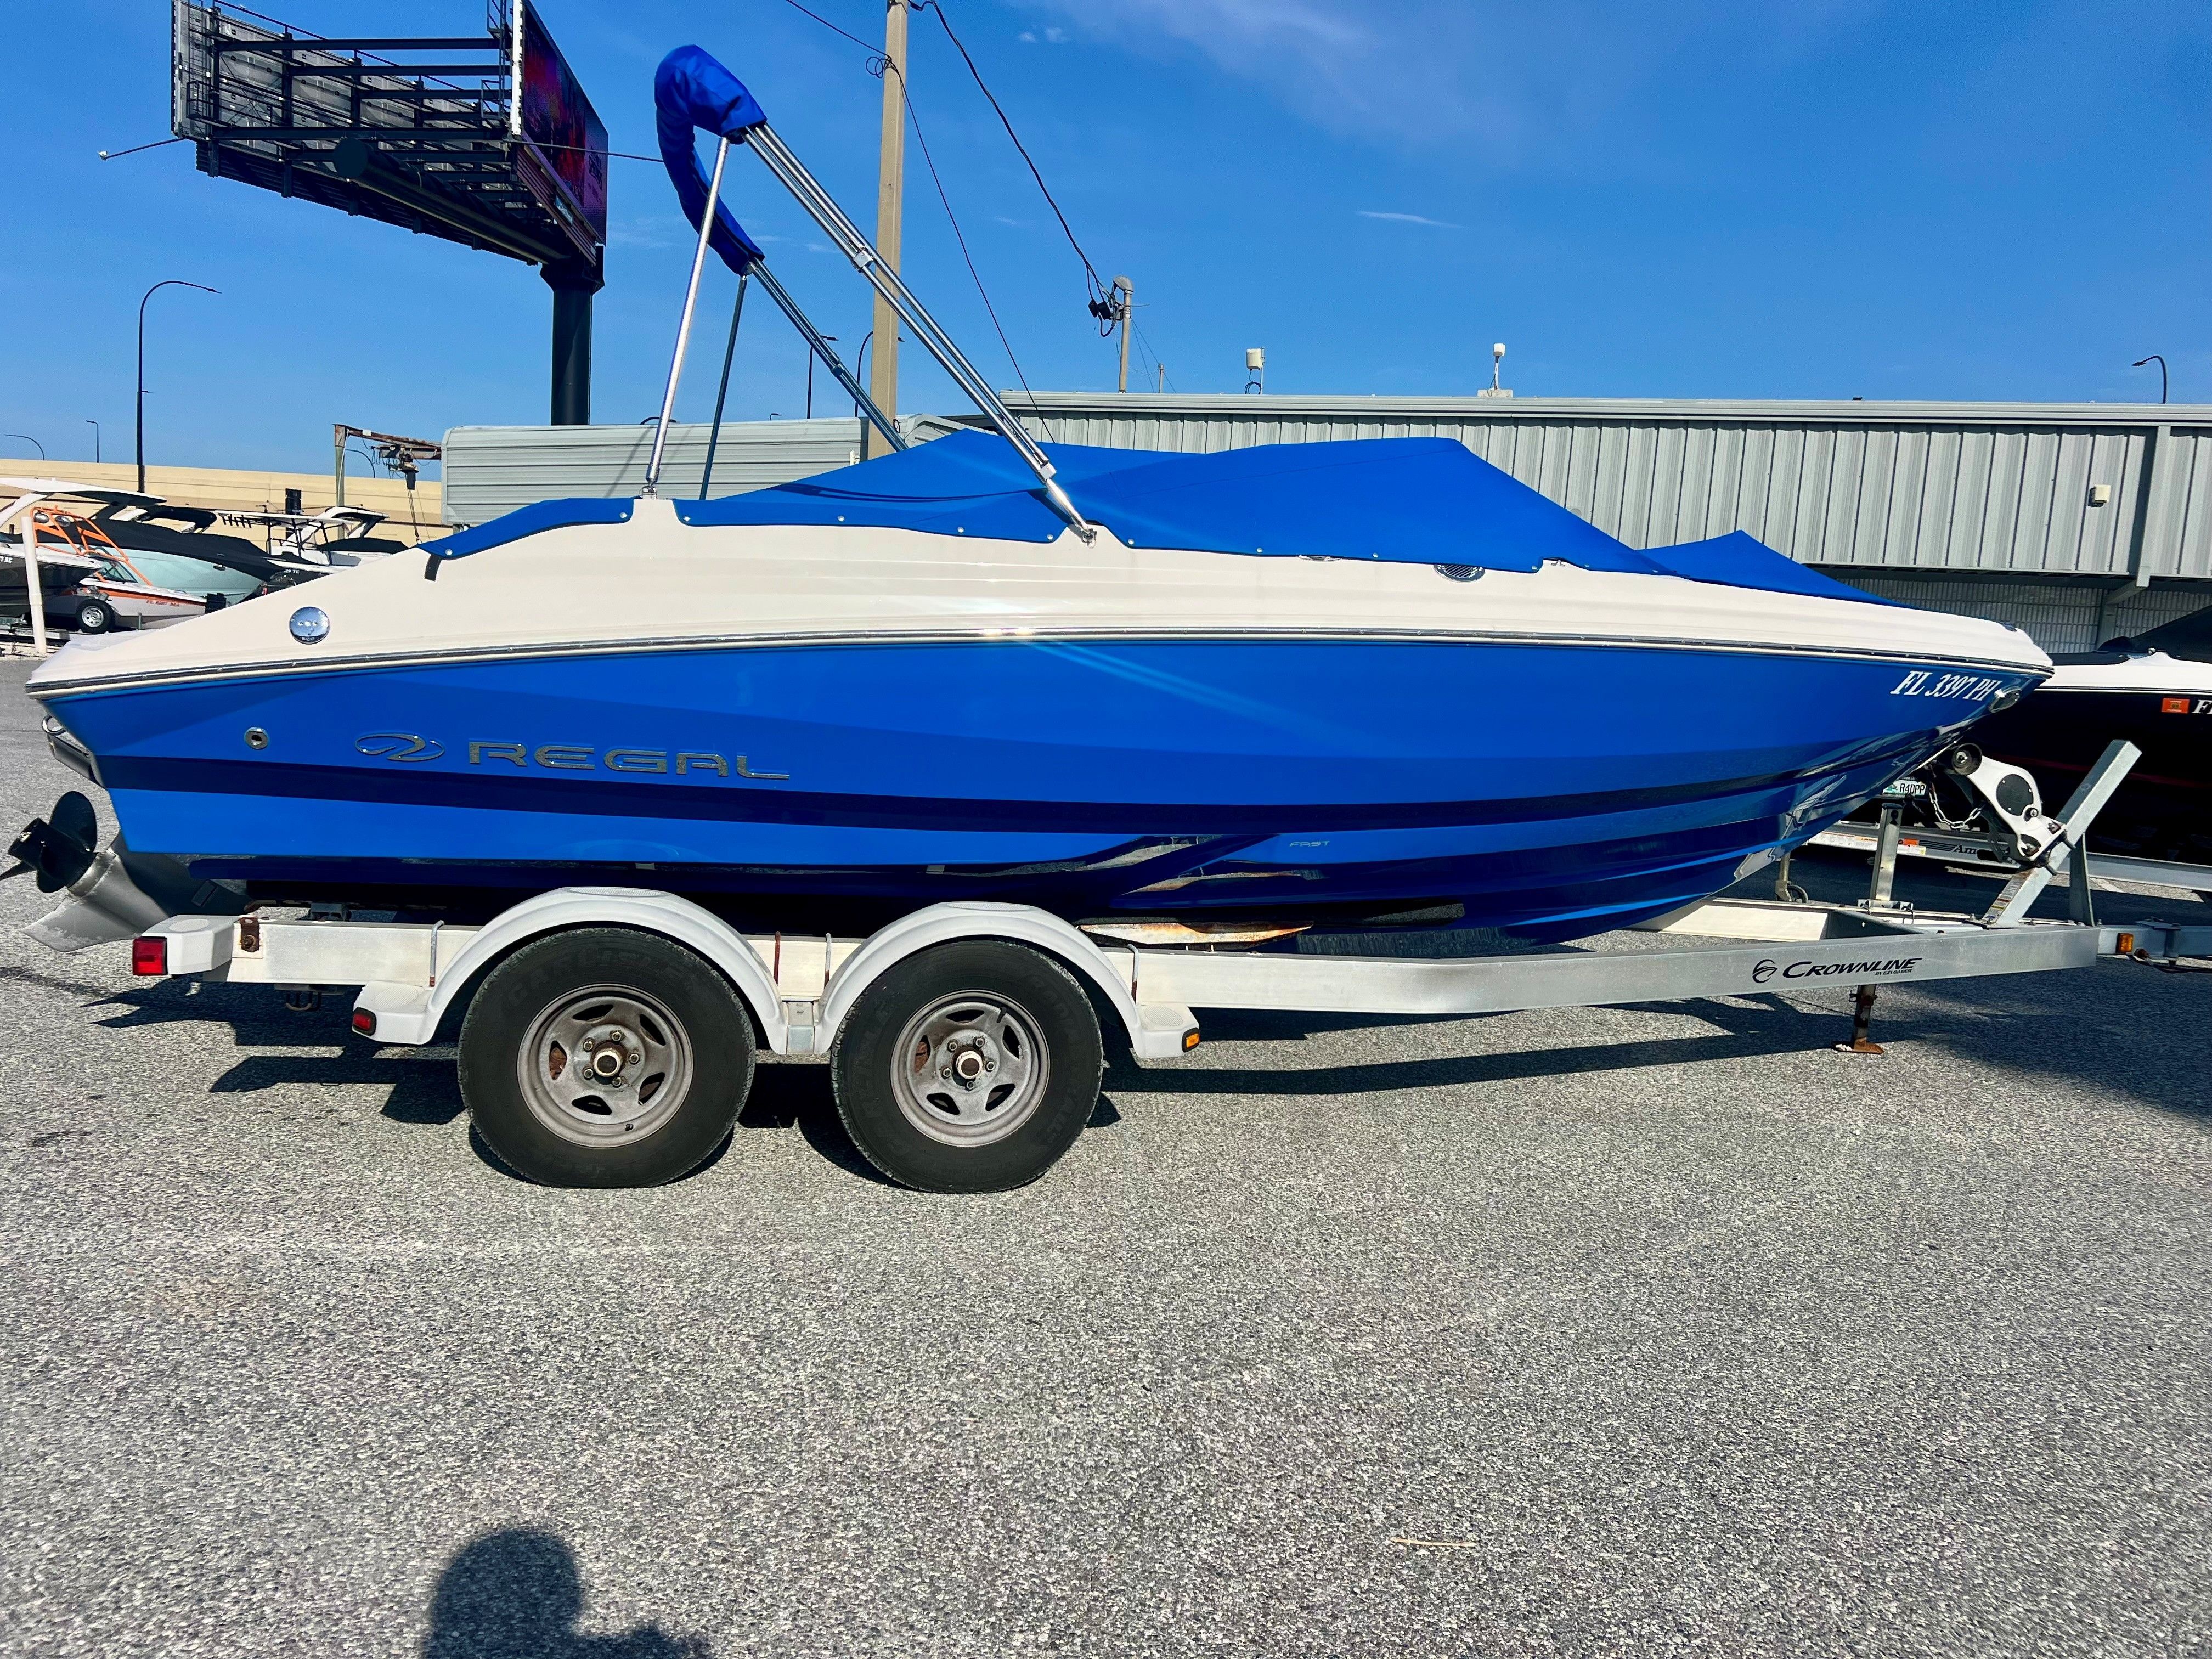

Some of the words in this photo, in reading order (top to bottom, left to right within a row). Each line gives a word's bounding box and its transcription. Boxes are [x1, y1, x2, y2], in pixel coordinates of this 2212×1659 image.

[1890, 670, 1932, 696] FL
[1925, 674, 1978, 699] 3397
[1962, 678, 2003, 701] PH
[469, 741, 789, 780] REGAL
[1782, 957, 1923, 978] CROWNLINE
